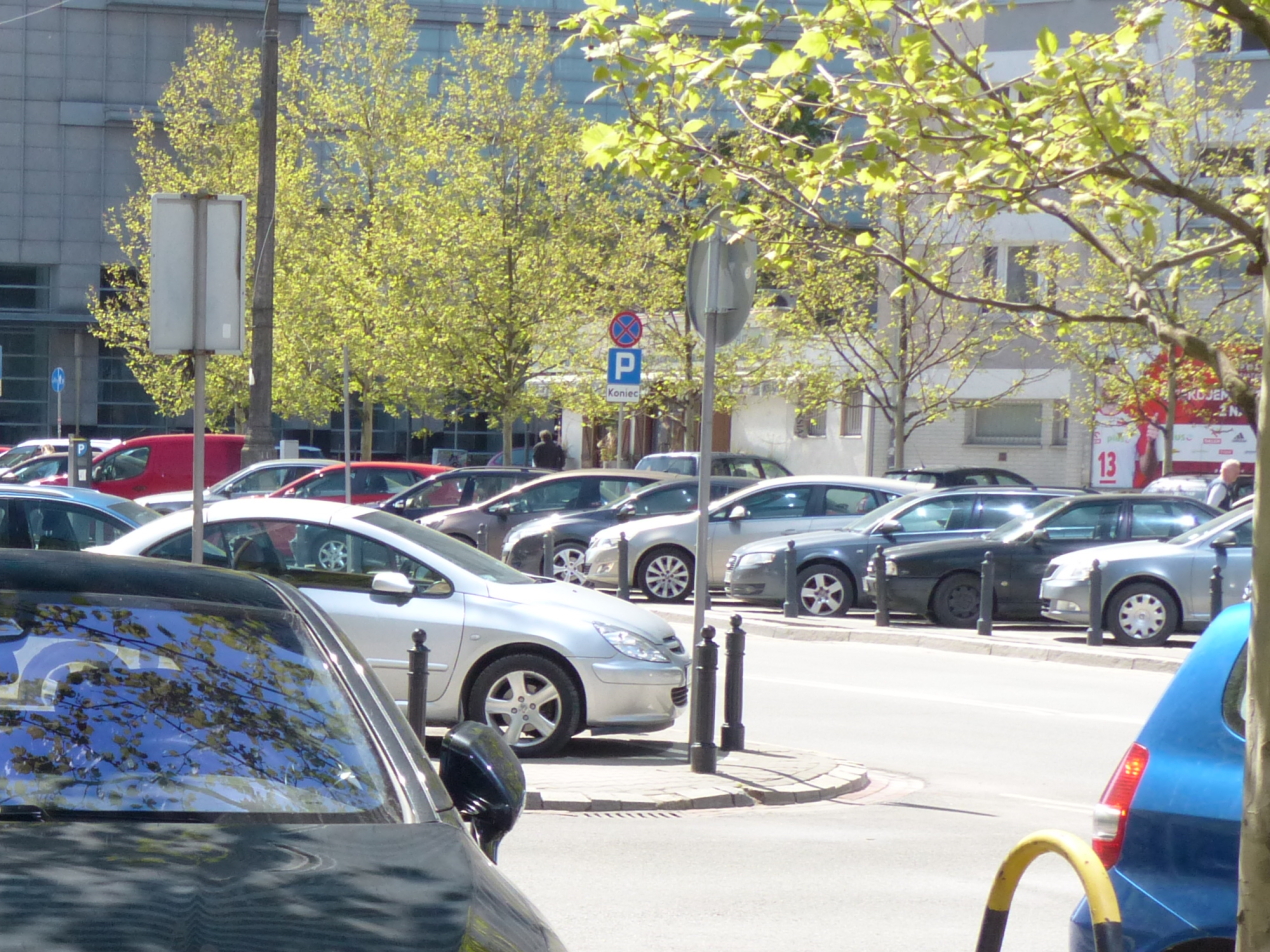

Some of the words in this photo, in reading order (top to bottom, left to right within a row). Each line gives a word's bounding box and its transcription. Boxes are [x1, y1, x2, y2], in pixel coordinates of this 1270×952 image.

[615, 352, 635, 380] P
[608, 387, 639, 398] Koniec
[77, 443, 85, 455] P
[1098, 451, 1116, 477] 13
